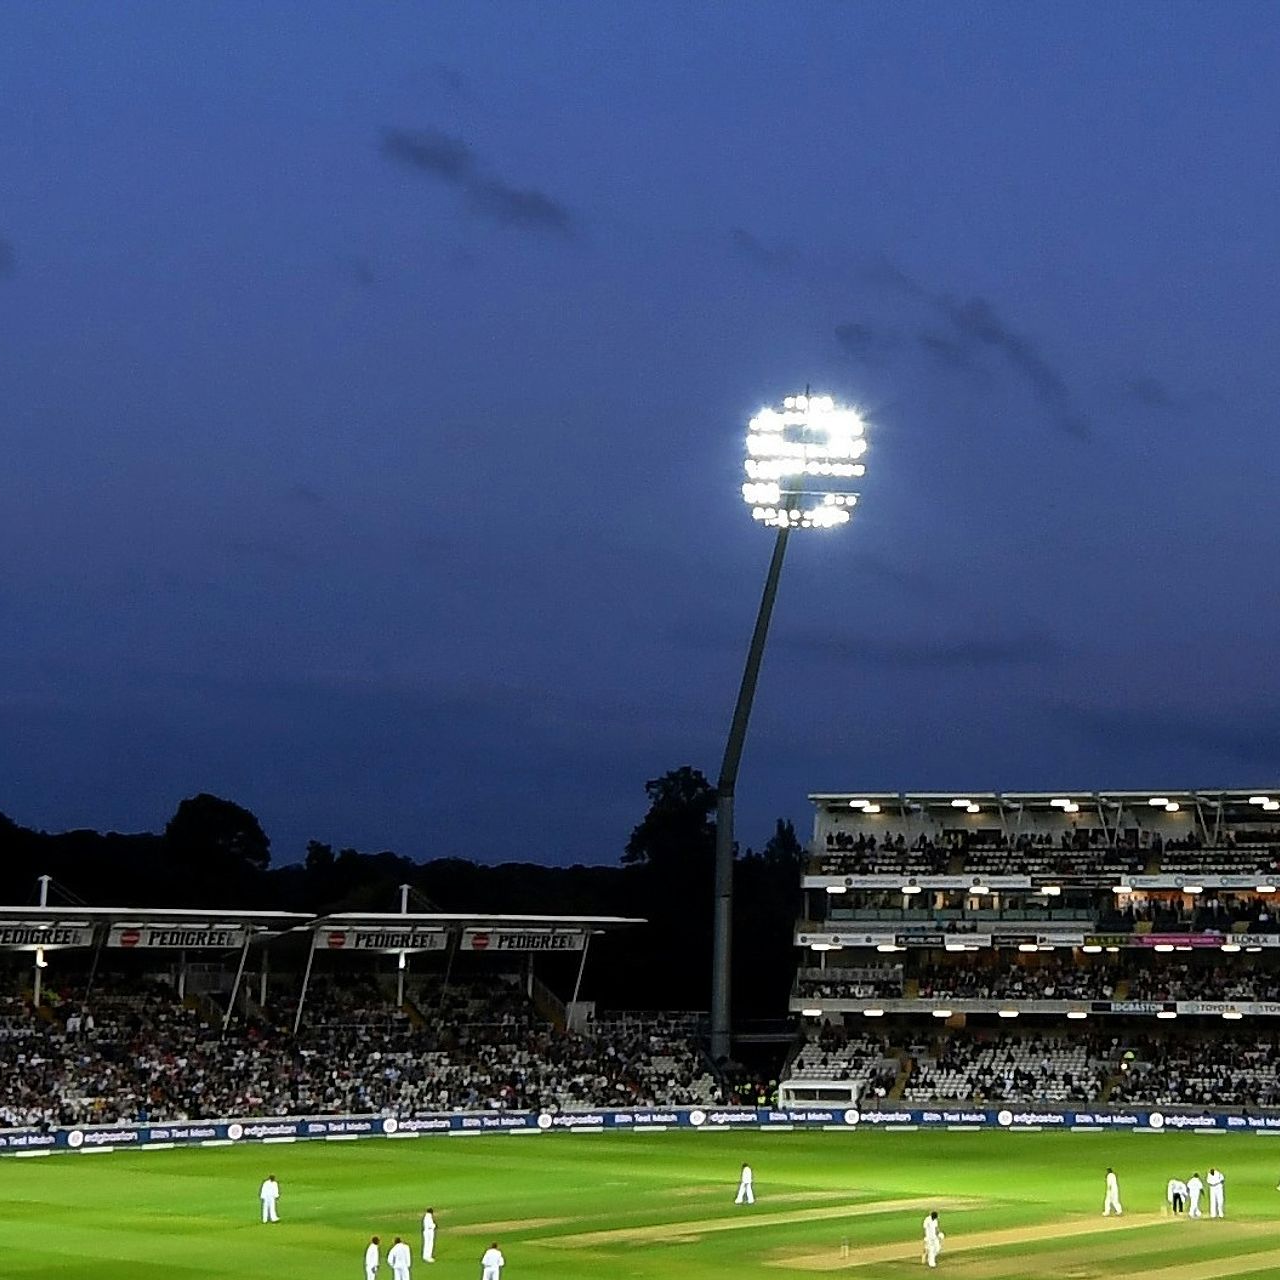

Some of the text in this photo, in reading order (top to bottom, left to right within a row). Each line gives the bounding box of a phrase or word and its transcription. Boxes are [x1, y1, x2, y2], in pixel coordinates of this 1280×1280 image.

[147, 930, 225, 947] PEDIGREE
[354, 932, 429, 949] PEDIGREE
[497, 934, 569, 950] PEDIGREE
